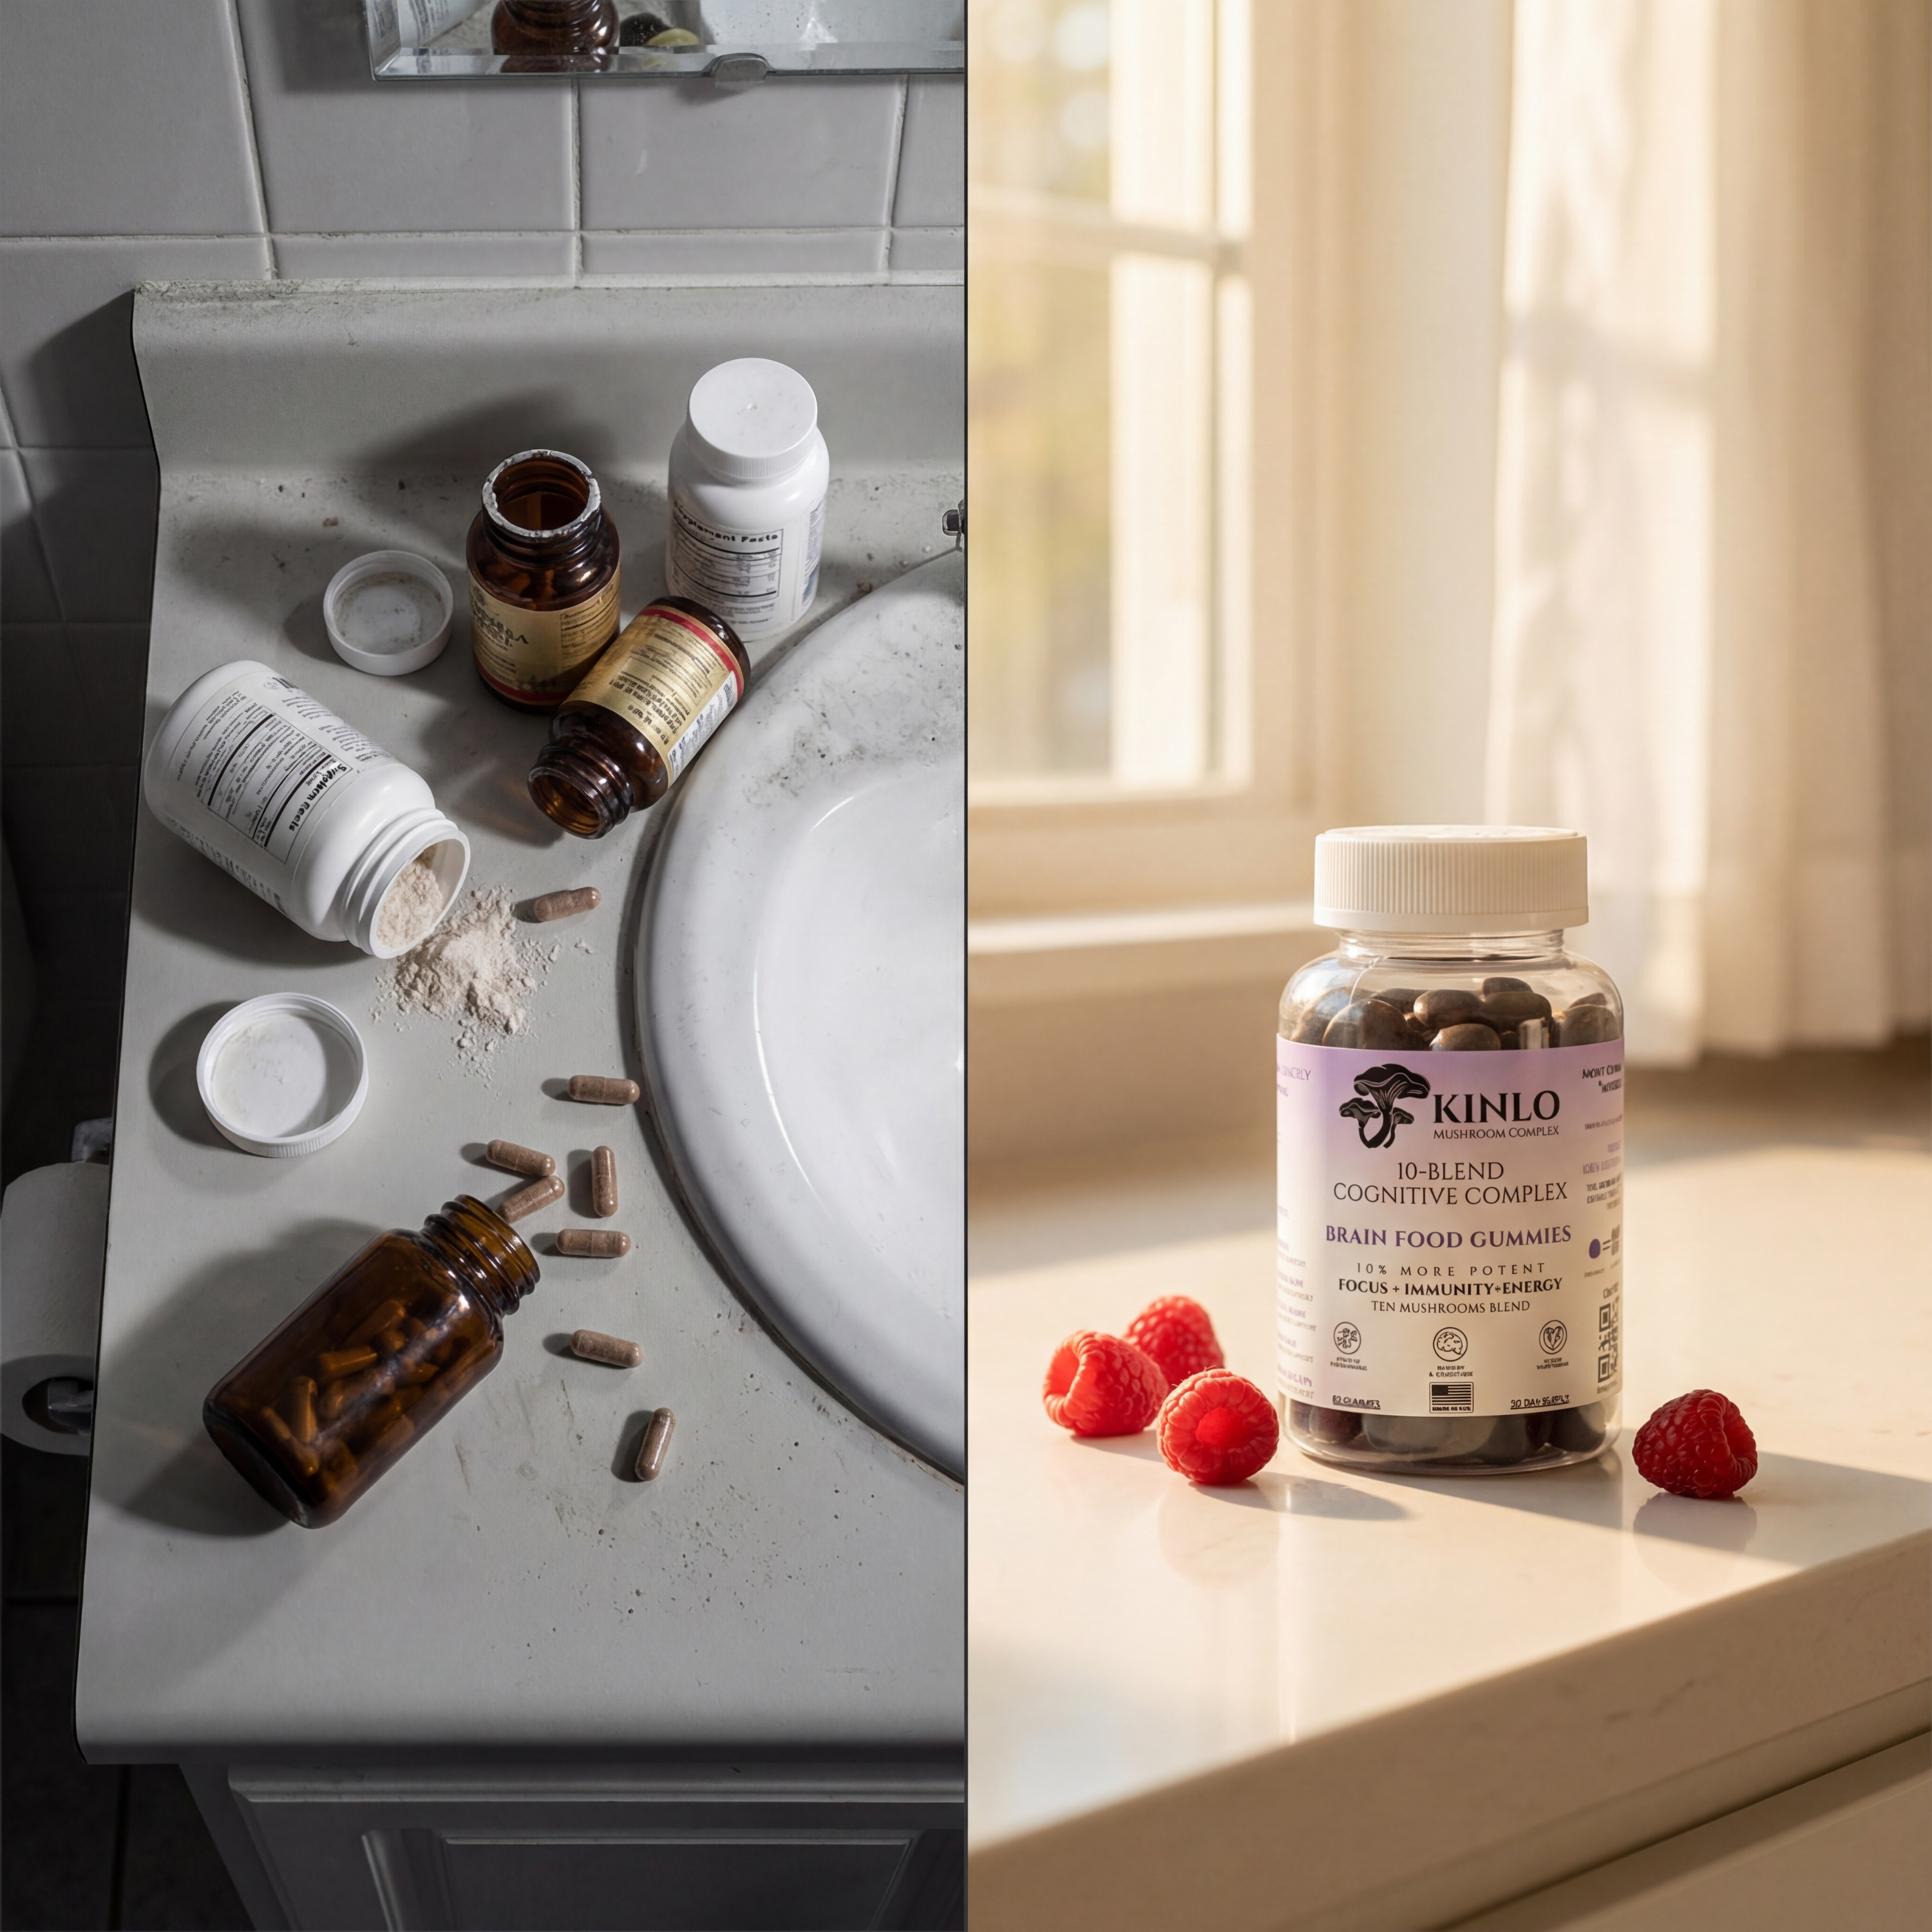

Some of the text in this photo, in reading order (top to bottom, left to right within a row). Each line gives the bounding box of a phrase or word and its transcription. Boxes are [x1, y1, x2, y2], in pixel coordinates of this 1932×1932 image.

[1433, 1090, 1560, 1124] KINLO
[1434, 1125, 1560, 1139] MUSHROOM COMPLEX
[1397, 1162, 1504, 1180] 10-BLEND
[1333, 1182, 1458, 1205] COGNITIVE
[1464, 1182, 1568, 1205] COMPLEX
[1325, 1225, 1571, 1248] BRAIN FOOD GUMMIES
[1356, 1262, 1545, 1276] 10% MORE POTENT
[1338, 1278, 1388, 1294] FOCUS
[1371, 1300, 1530, 1314] TEN MUSHROOMS BLEND
